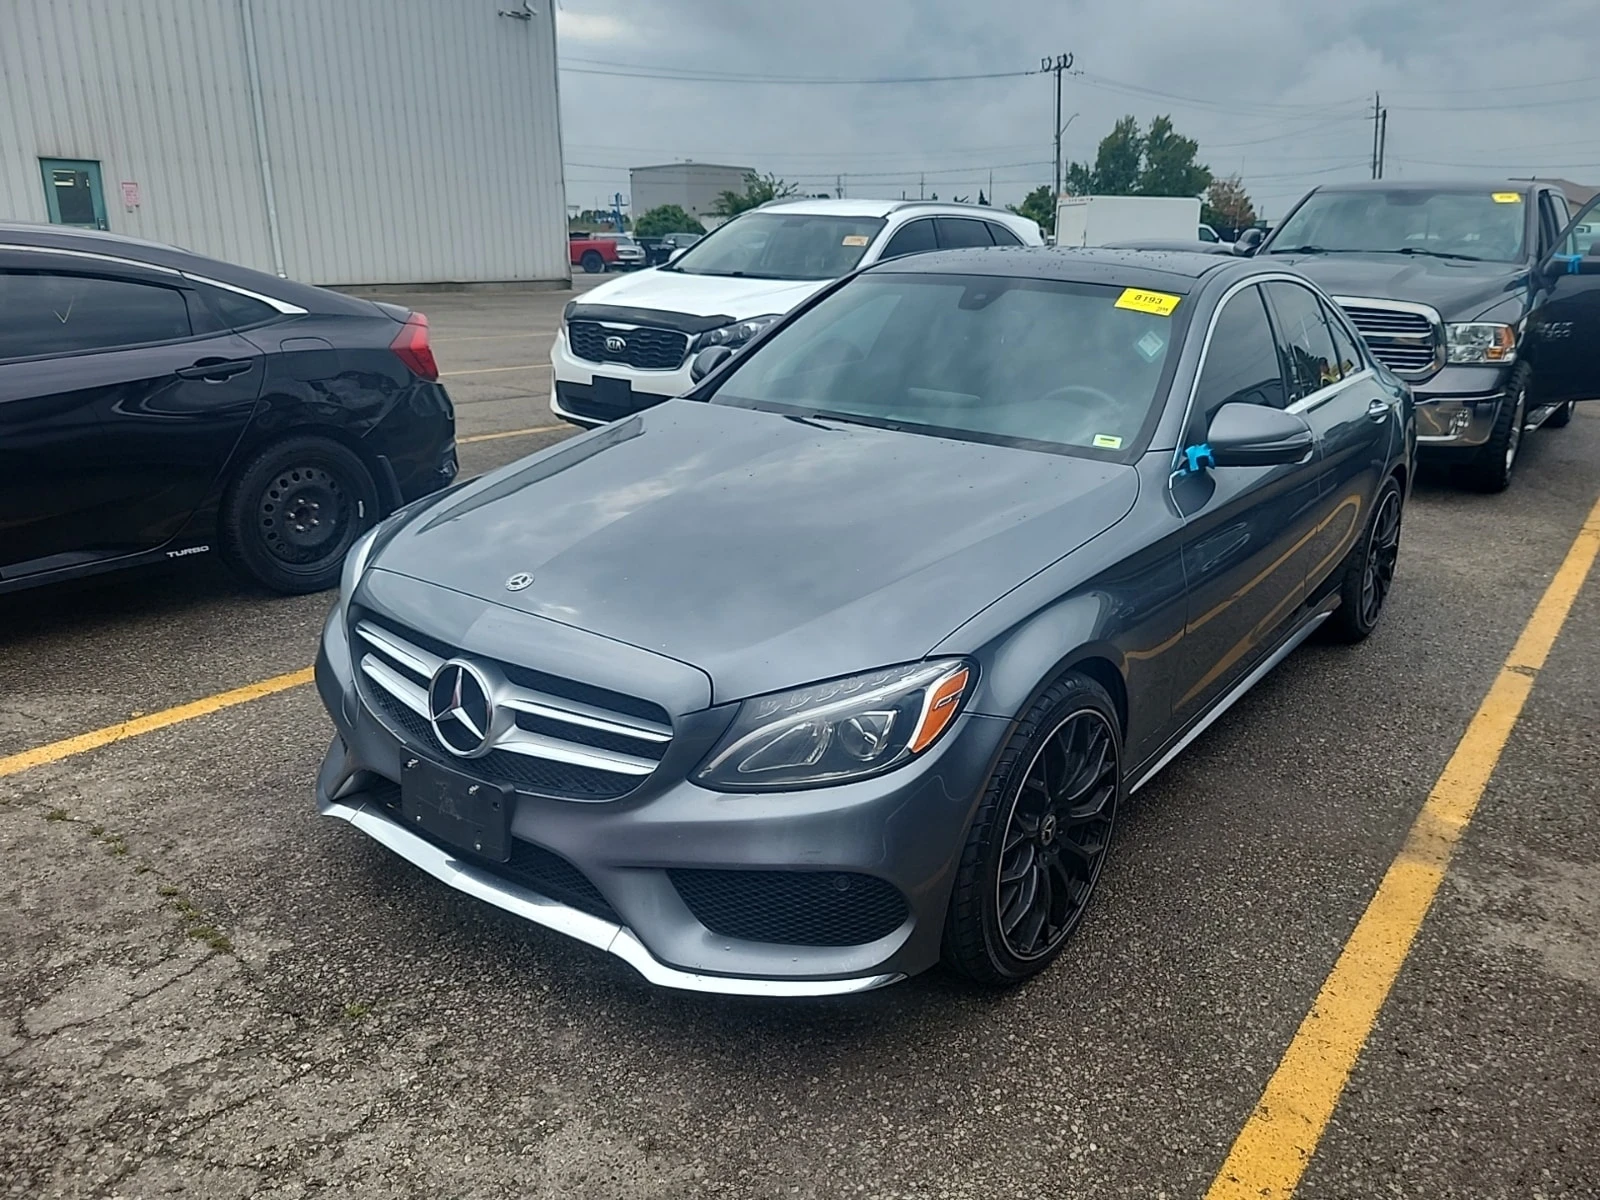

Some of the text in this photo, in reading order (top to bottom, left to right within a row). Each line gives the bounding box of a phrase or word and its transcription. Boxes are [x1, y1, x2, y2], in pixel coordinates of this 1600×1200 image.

[1134, 294, 1163, 305] 8193
[606, 338, 624, 351] KIA
[166, 545, 209, 557] TURBO
